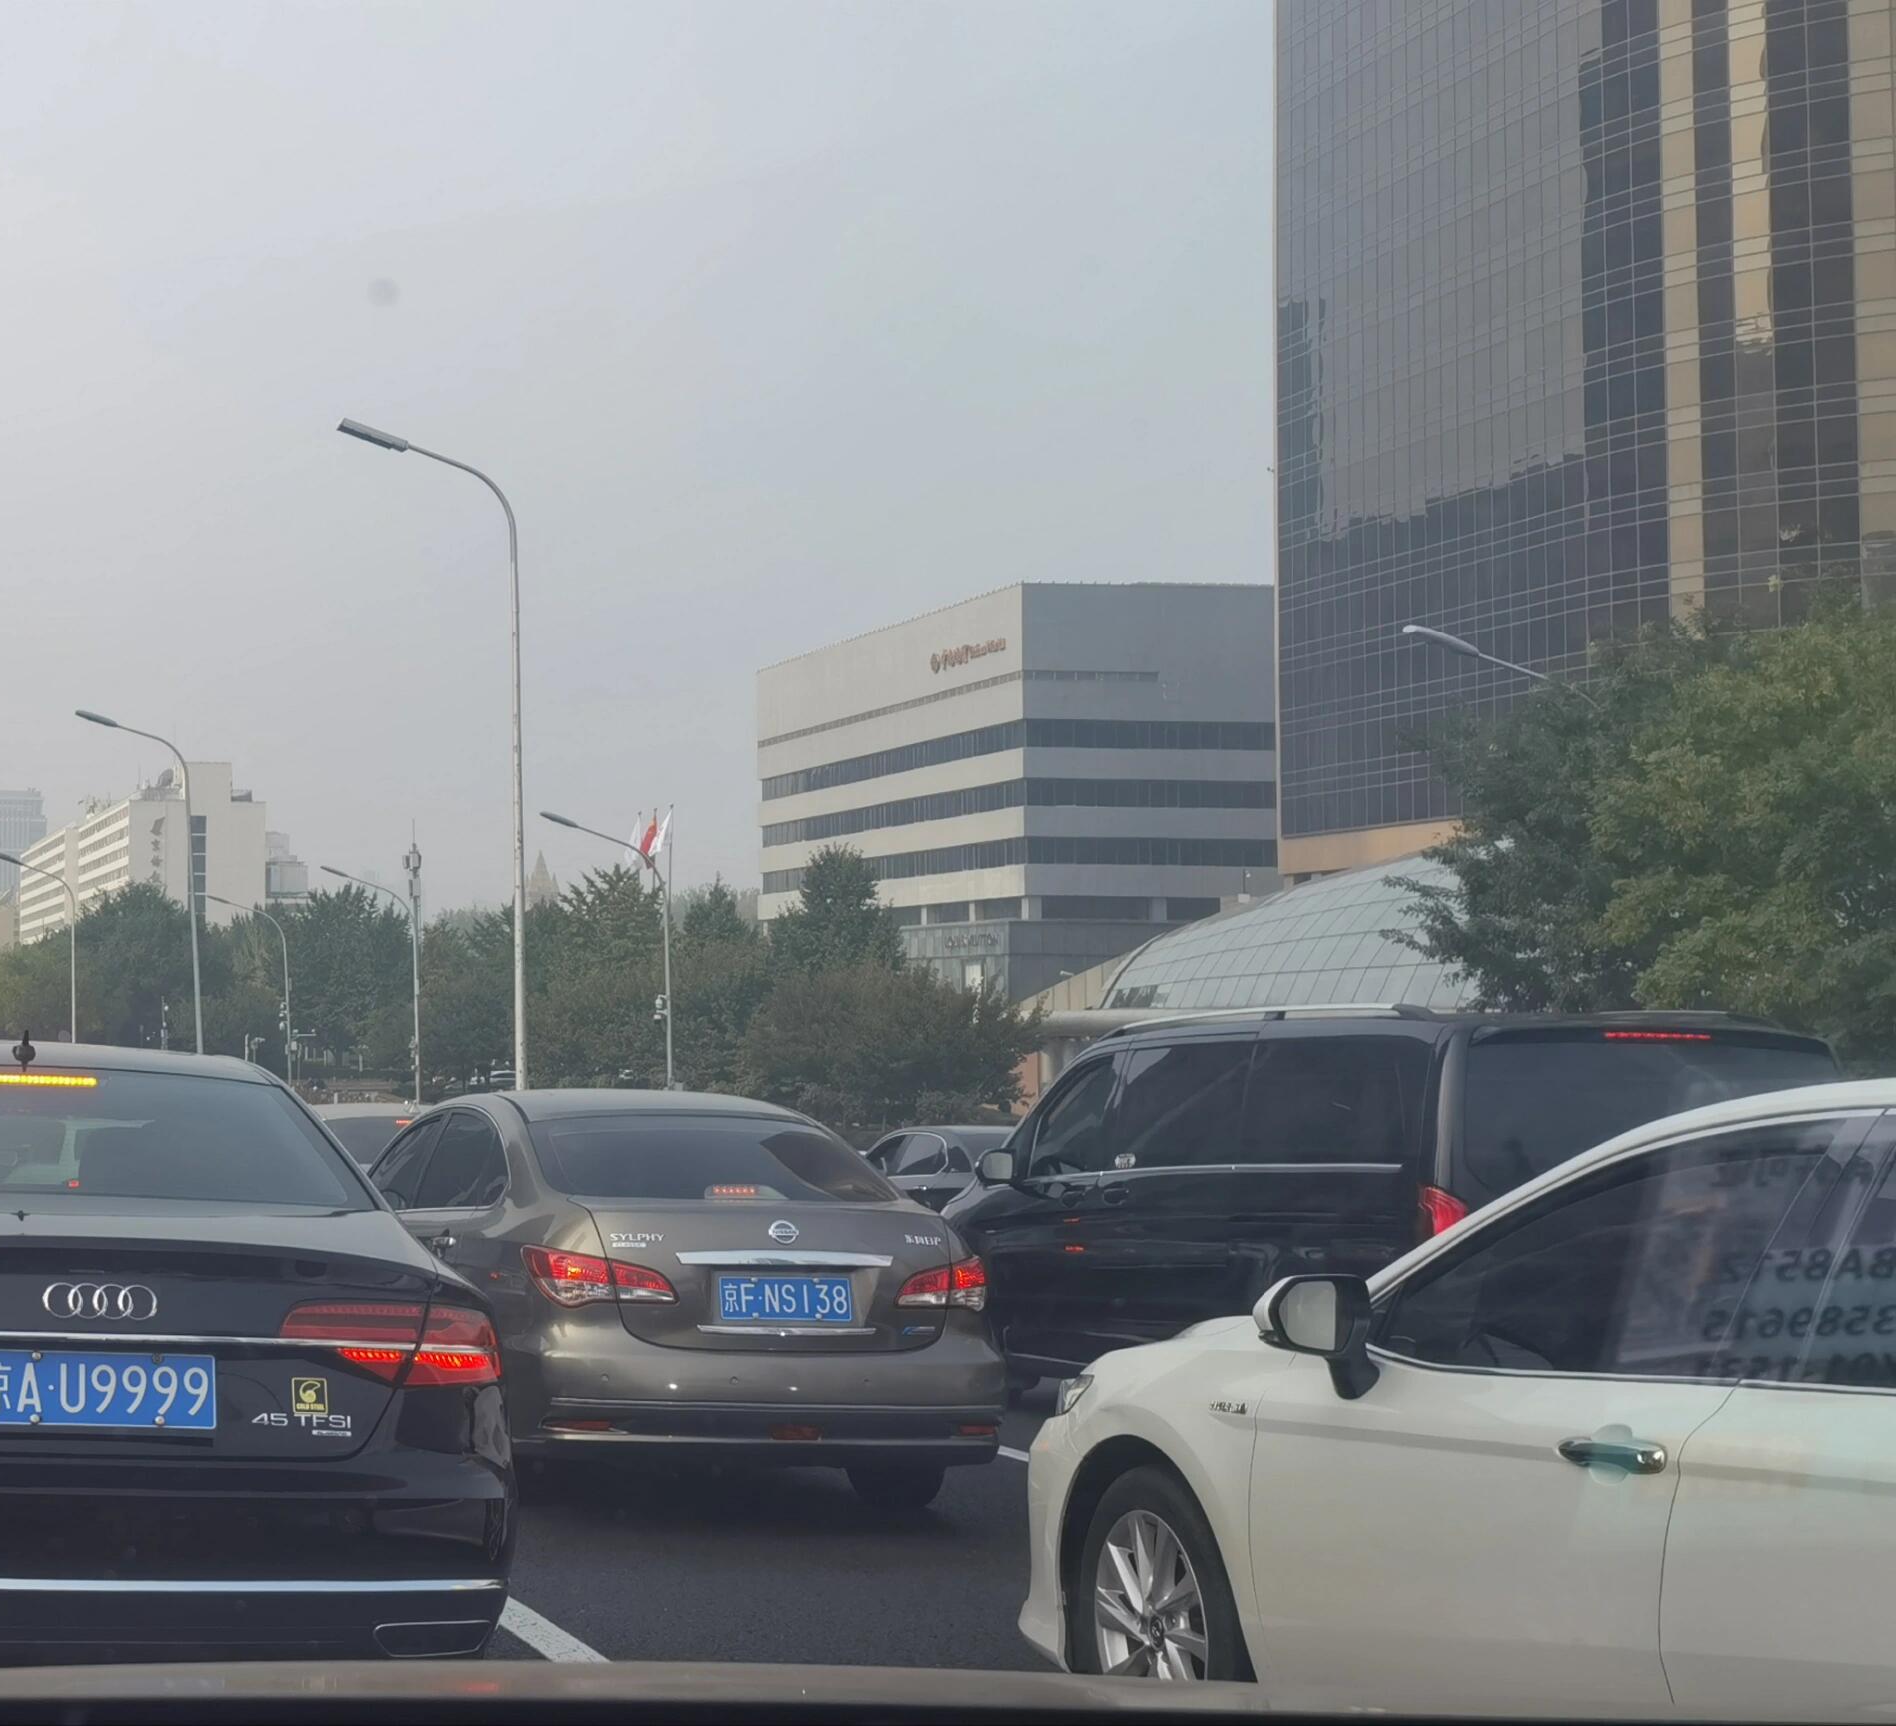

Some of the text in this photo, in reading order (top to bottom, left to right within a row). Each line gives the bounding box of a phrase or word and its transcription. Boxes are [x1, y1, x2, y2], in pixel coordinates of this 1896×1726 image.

[610, 1233, 664, 1242] SYLPHY
[251, 1412, 351, 1428] 45 TFSI
